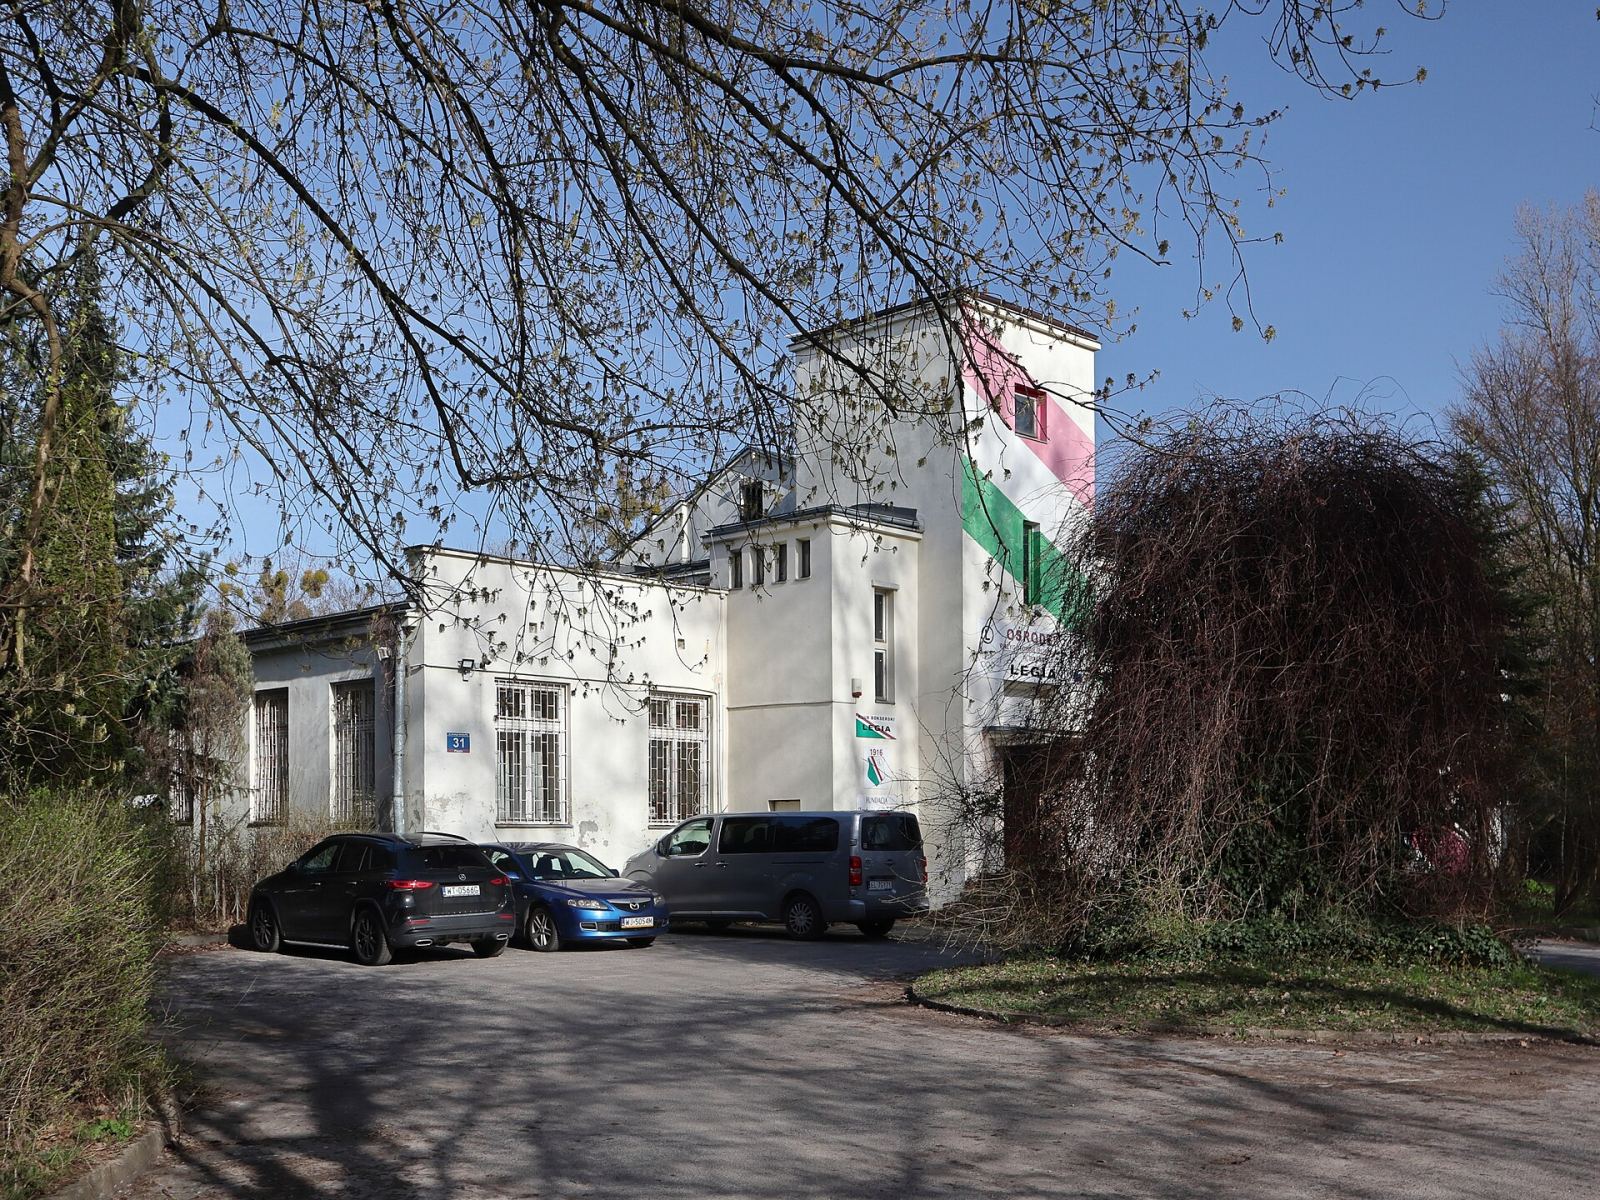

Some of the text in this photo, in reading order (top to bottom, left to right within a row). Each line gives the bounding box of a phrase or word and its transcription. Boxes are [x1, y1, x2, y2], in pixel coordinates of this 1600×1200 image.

[1010, 664, 1056, 679] LEGIA
[862, 724, 891, 732] LEGIA
[453, 737, 465, 748] 31
[870, 748, 883, 756] 1916
